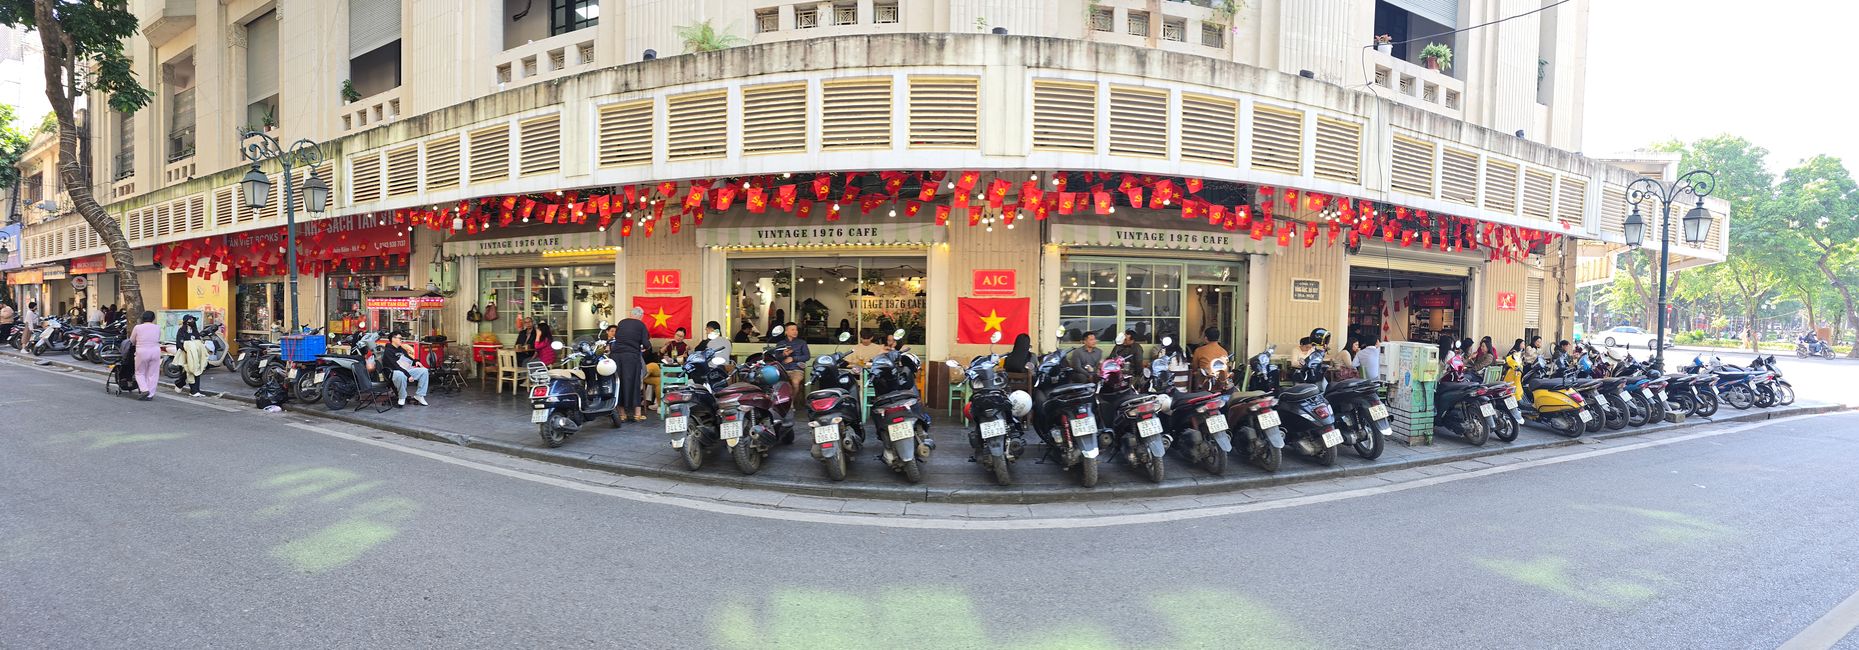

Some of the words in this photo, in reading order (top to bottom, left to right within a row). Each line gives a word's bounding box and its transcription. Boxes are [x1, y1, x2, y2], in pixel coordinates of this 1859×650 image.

[758, 229, 808, 238] VINTAGE
[813, 229, 843, 237] 1976
[848, 228, 878, 237] CAFE
[1116, 231, 1165, 241] VINTAGE
[1170, 234, 1197, 243] 1976
[1202, 235, 1229, 245] CAFE
[480, 241, 512, 250] VINTAGE
[515, 239, 535, 248] 1976
[538, 237, 559, 246] CAFE
[652, 275, 674, 286] AJC
[982, 275, 1008, 286] AJC
[849, 299, 882, 309] VITAGE
[885, 299, 905, 309] 1976
